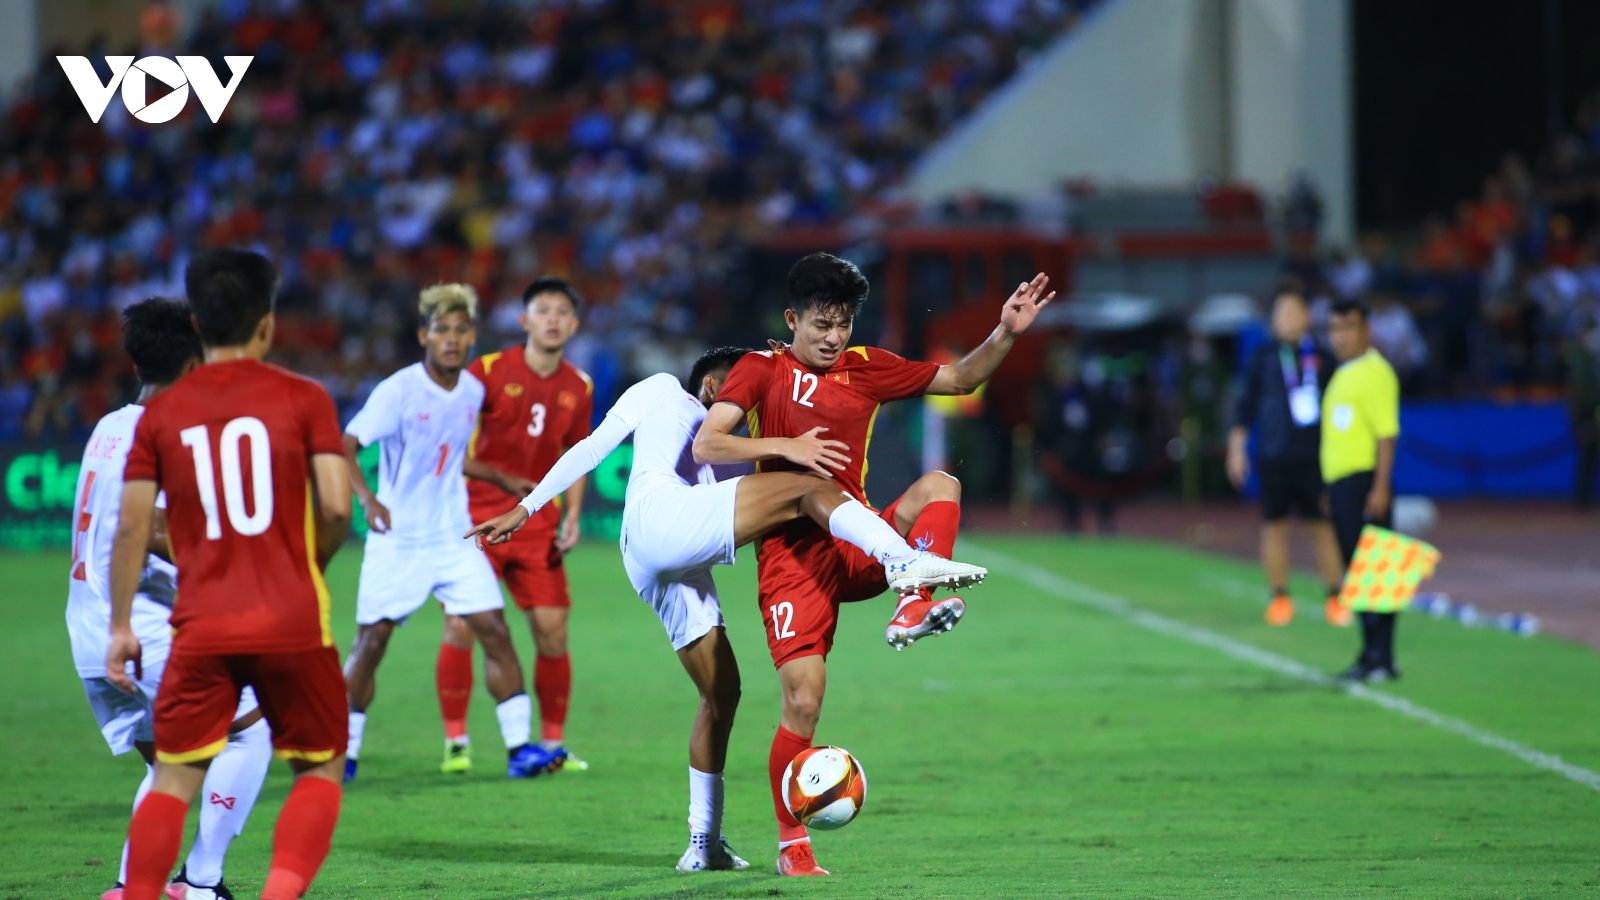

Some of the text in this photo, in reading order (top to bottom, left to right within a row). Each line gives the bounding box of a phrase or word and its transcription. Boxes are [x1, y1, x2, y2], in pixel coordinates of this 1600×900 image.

[792, 368, 818, 408] 12
[527, 403, 546, 437] 3
[180, 416, 274, 540] 10
[436, 443, 449, 477] 1
[769, 601, 796, 640] 12
